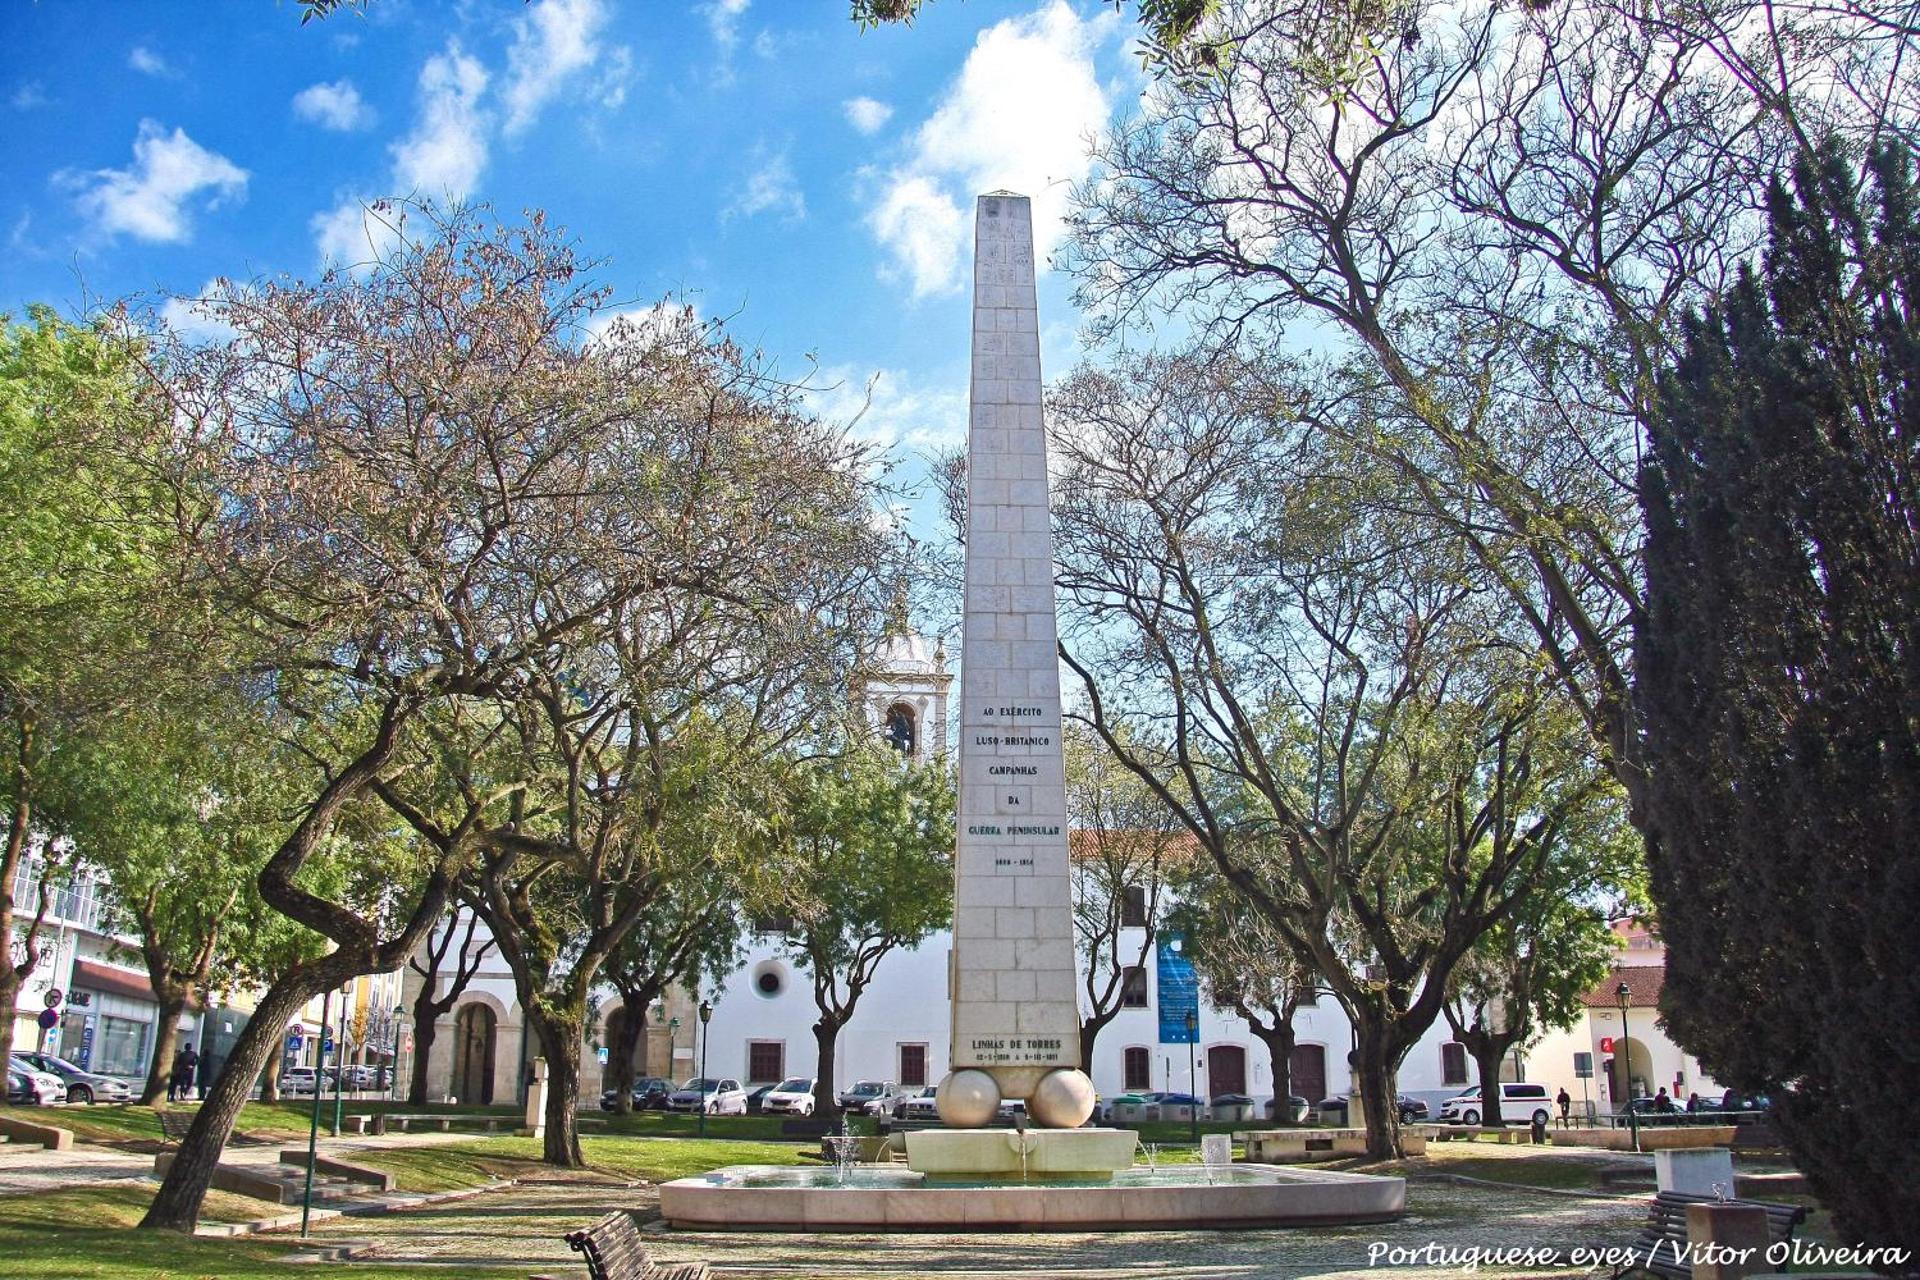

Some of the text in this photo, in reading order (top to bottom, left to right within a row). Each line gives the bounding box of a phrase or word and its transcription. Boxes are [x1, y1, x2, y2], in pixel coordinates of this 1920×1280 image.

[983, 707, 994, 716] AO
[989, 766, 1037, 775] CAMPANHAS
[1008, 796, 1019, 805] DA
[968, 826, 1060, 835] GUERRA PENINSULAR
[972, 1040, 1061, 1049] LINHAS DE TORRES
